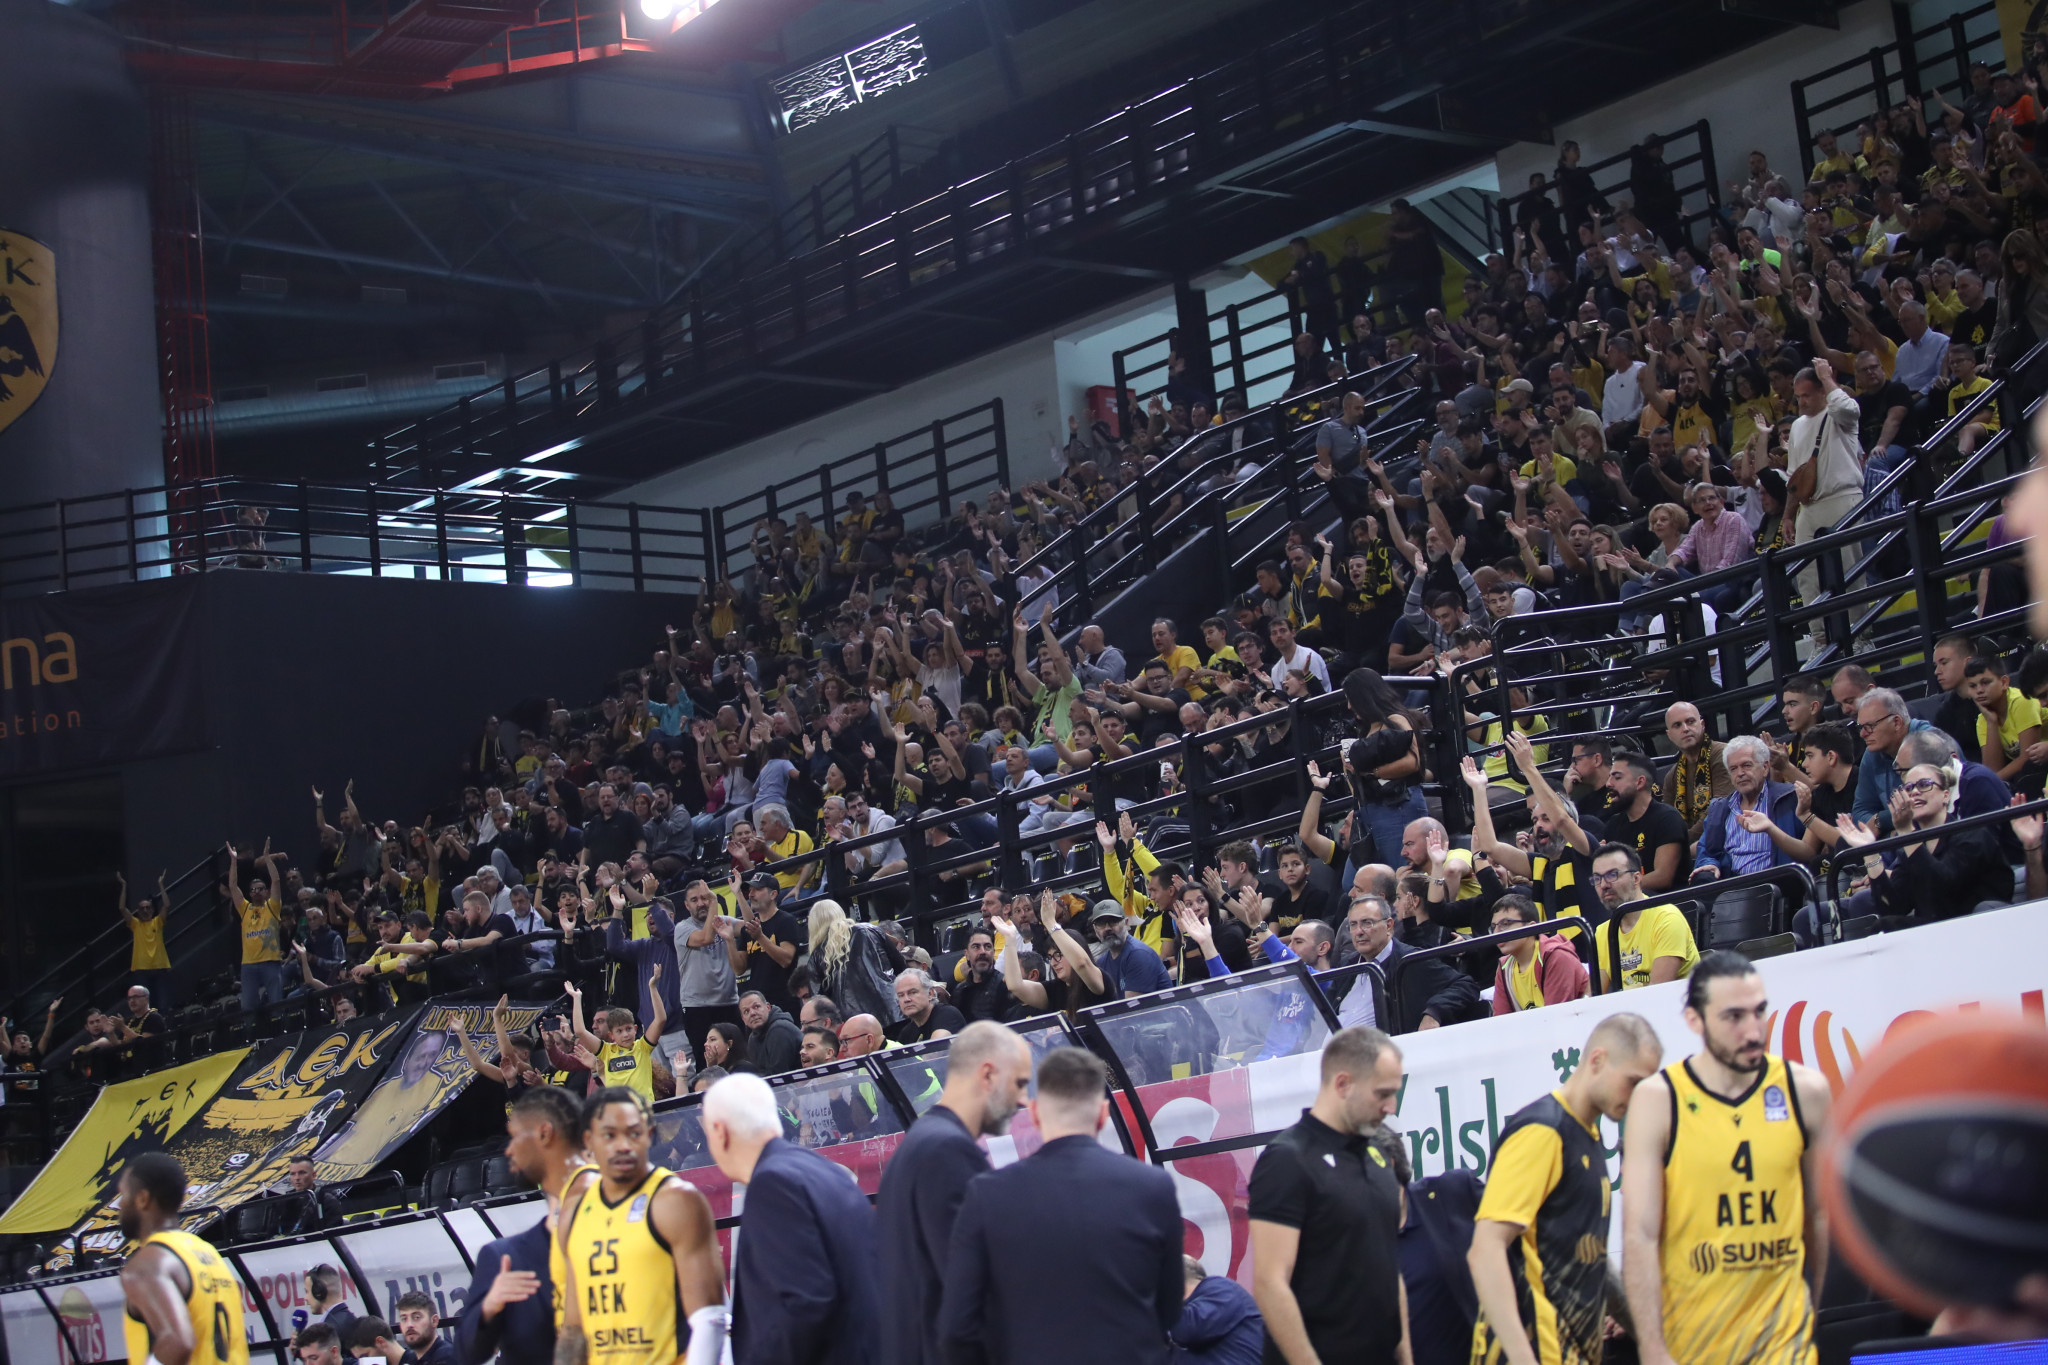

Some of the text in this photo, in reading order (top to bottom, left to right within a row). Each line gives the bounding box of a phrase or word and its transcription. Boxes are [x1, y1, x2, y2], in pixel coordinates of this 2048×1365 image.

[1731, 1140, 1753, 1182] 4
[1717, 1190, 1777, 1227] AEK
[589, 1239, 620, 1276] 25
[1722, 1237, 1798, 1263] SUNEL
[588, 1283, 626, 1315] AEK
